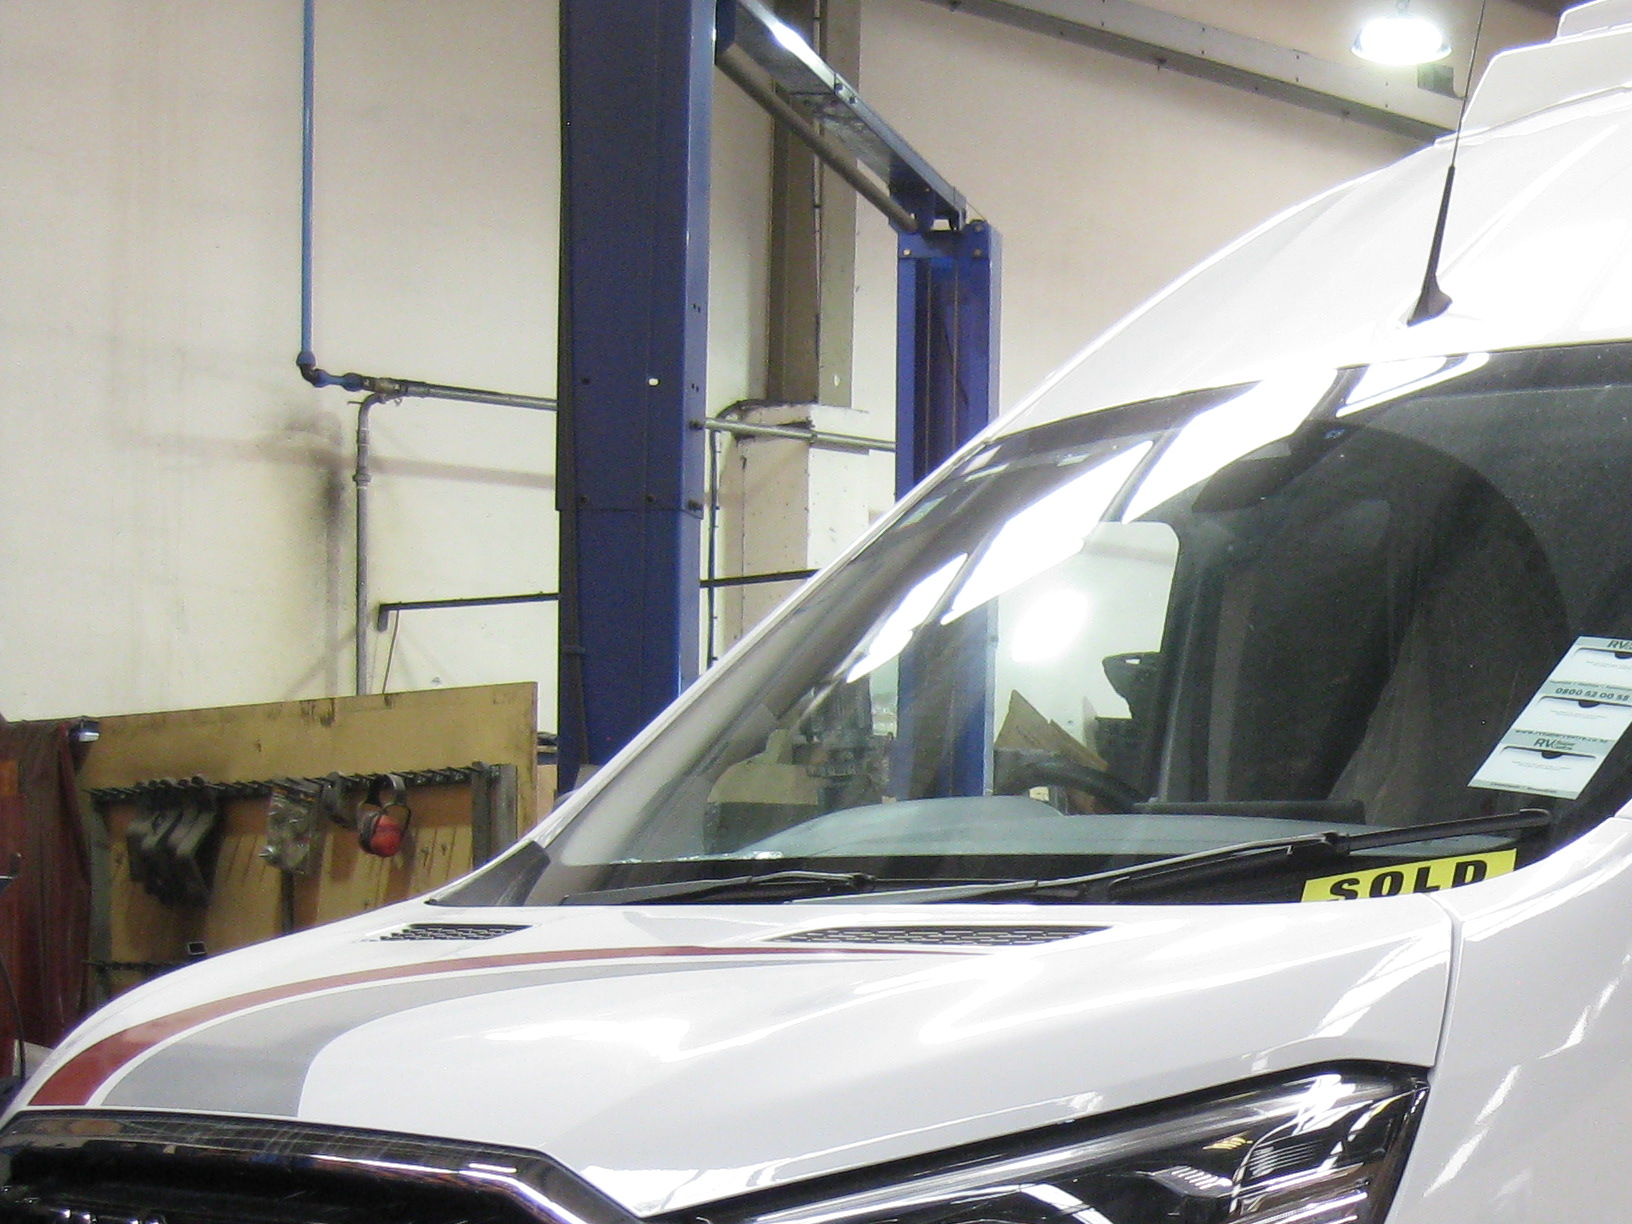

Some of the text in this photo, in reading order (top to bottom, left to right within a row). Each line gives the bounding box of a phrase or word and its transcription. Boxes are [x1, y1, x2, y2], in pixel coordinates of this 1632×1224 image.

[1607, 640, 1629, 650] RV
[1555, 687, 1582, 696] 0800
[1533, 738, 1555, 748] RV
[1329, 859, 1488, 901] SOLD
